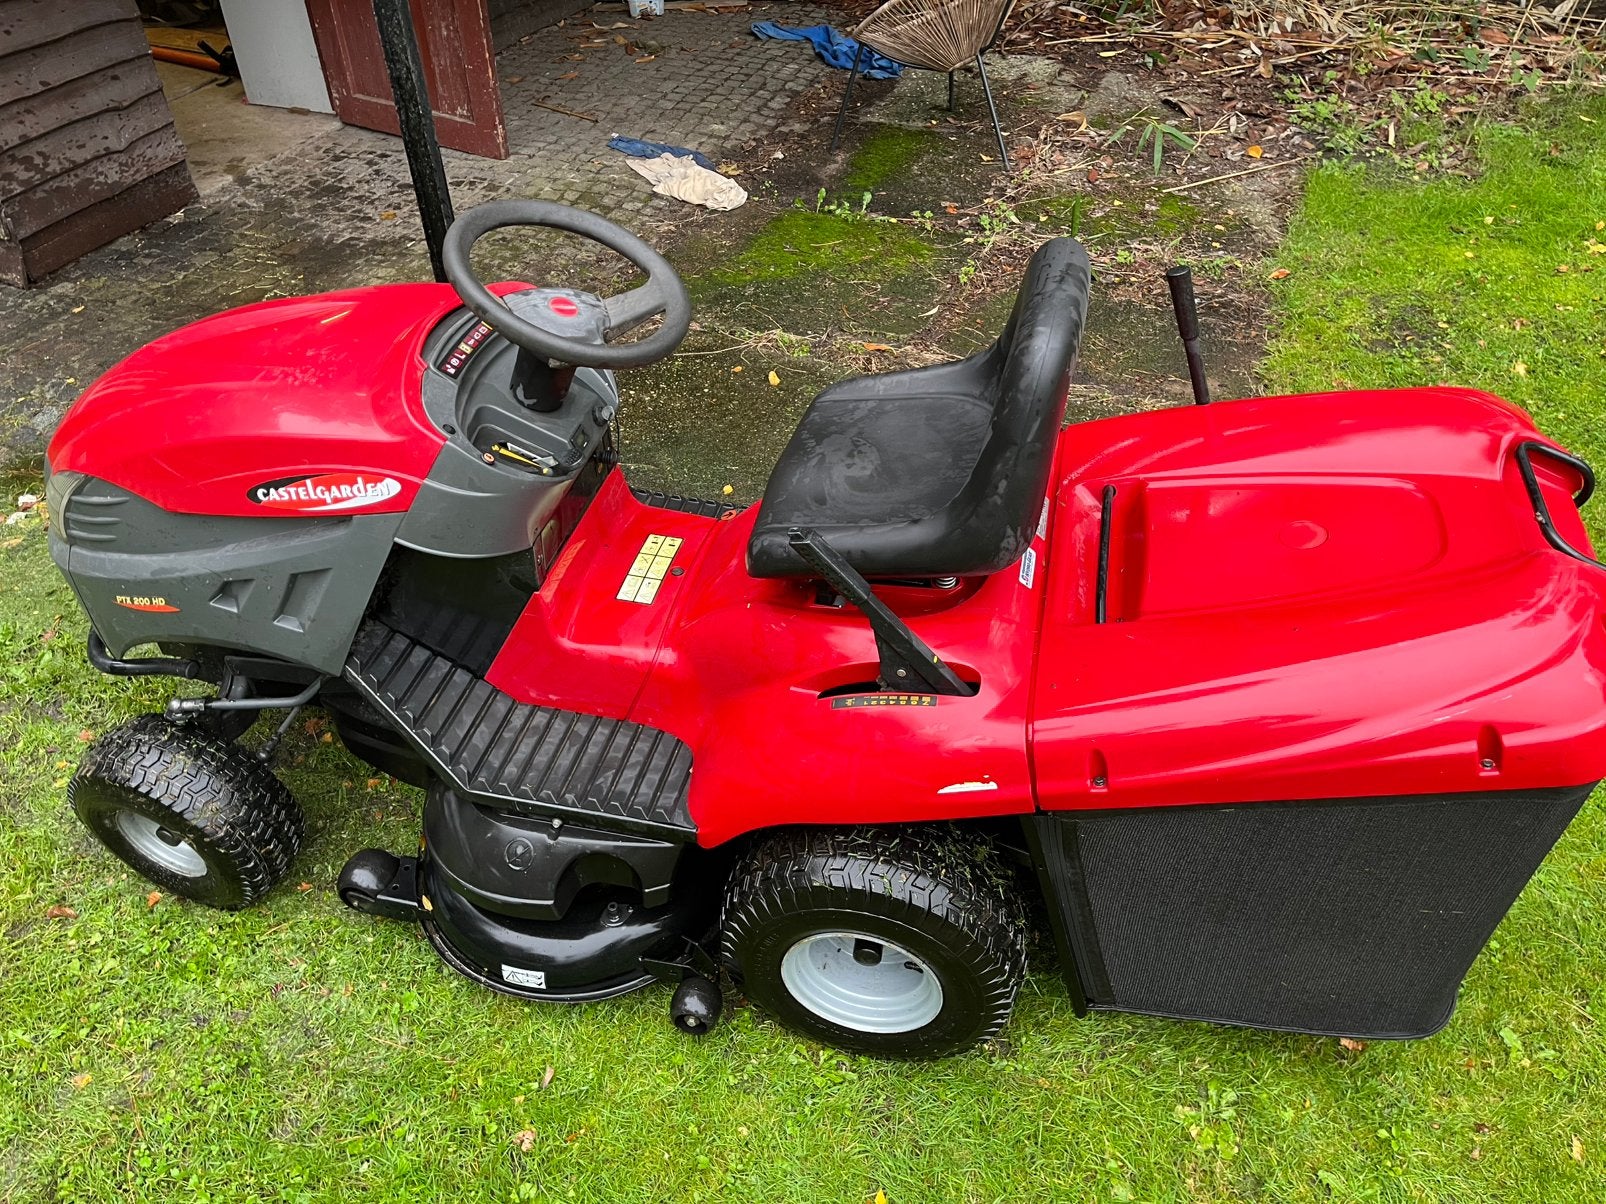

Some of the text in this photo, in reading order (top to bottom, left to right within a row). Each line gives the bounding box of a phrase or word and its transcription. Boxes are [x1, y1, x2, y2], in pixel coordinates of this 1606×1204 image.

[116, 595, 166, 606] PTX 200 HD
